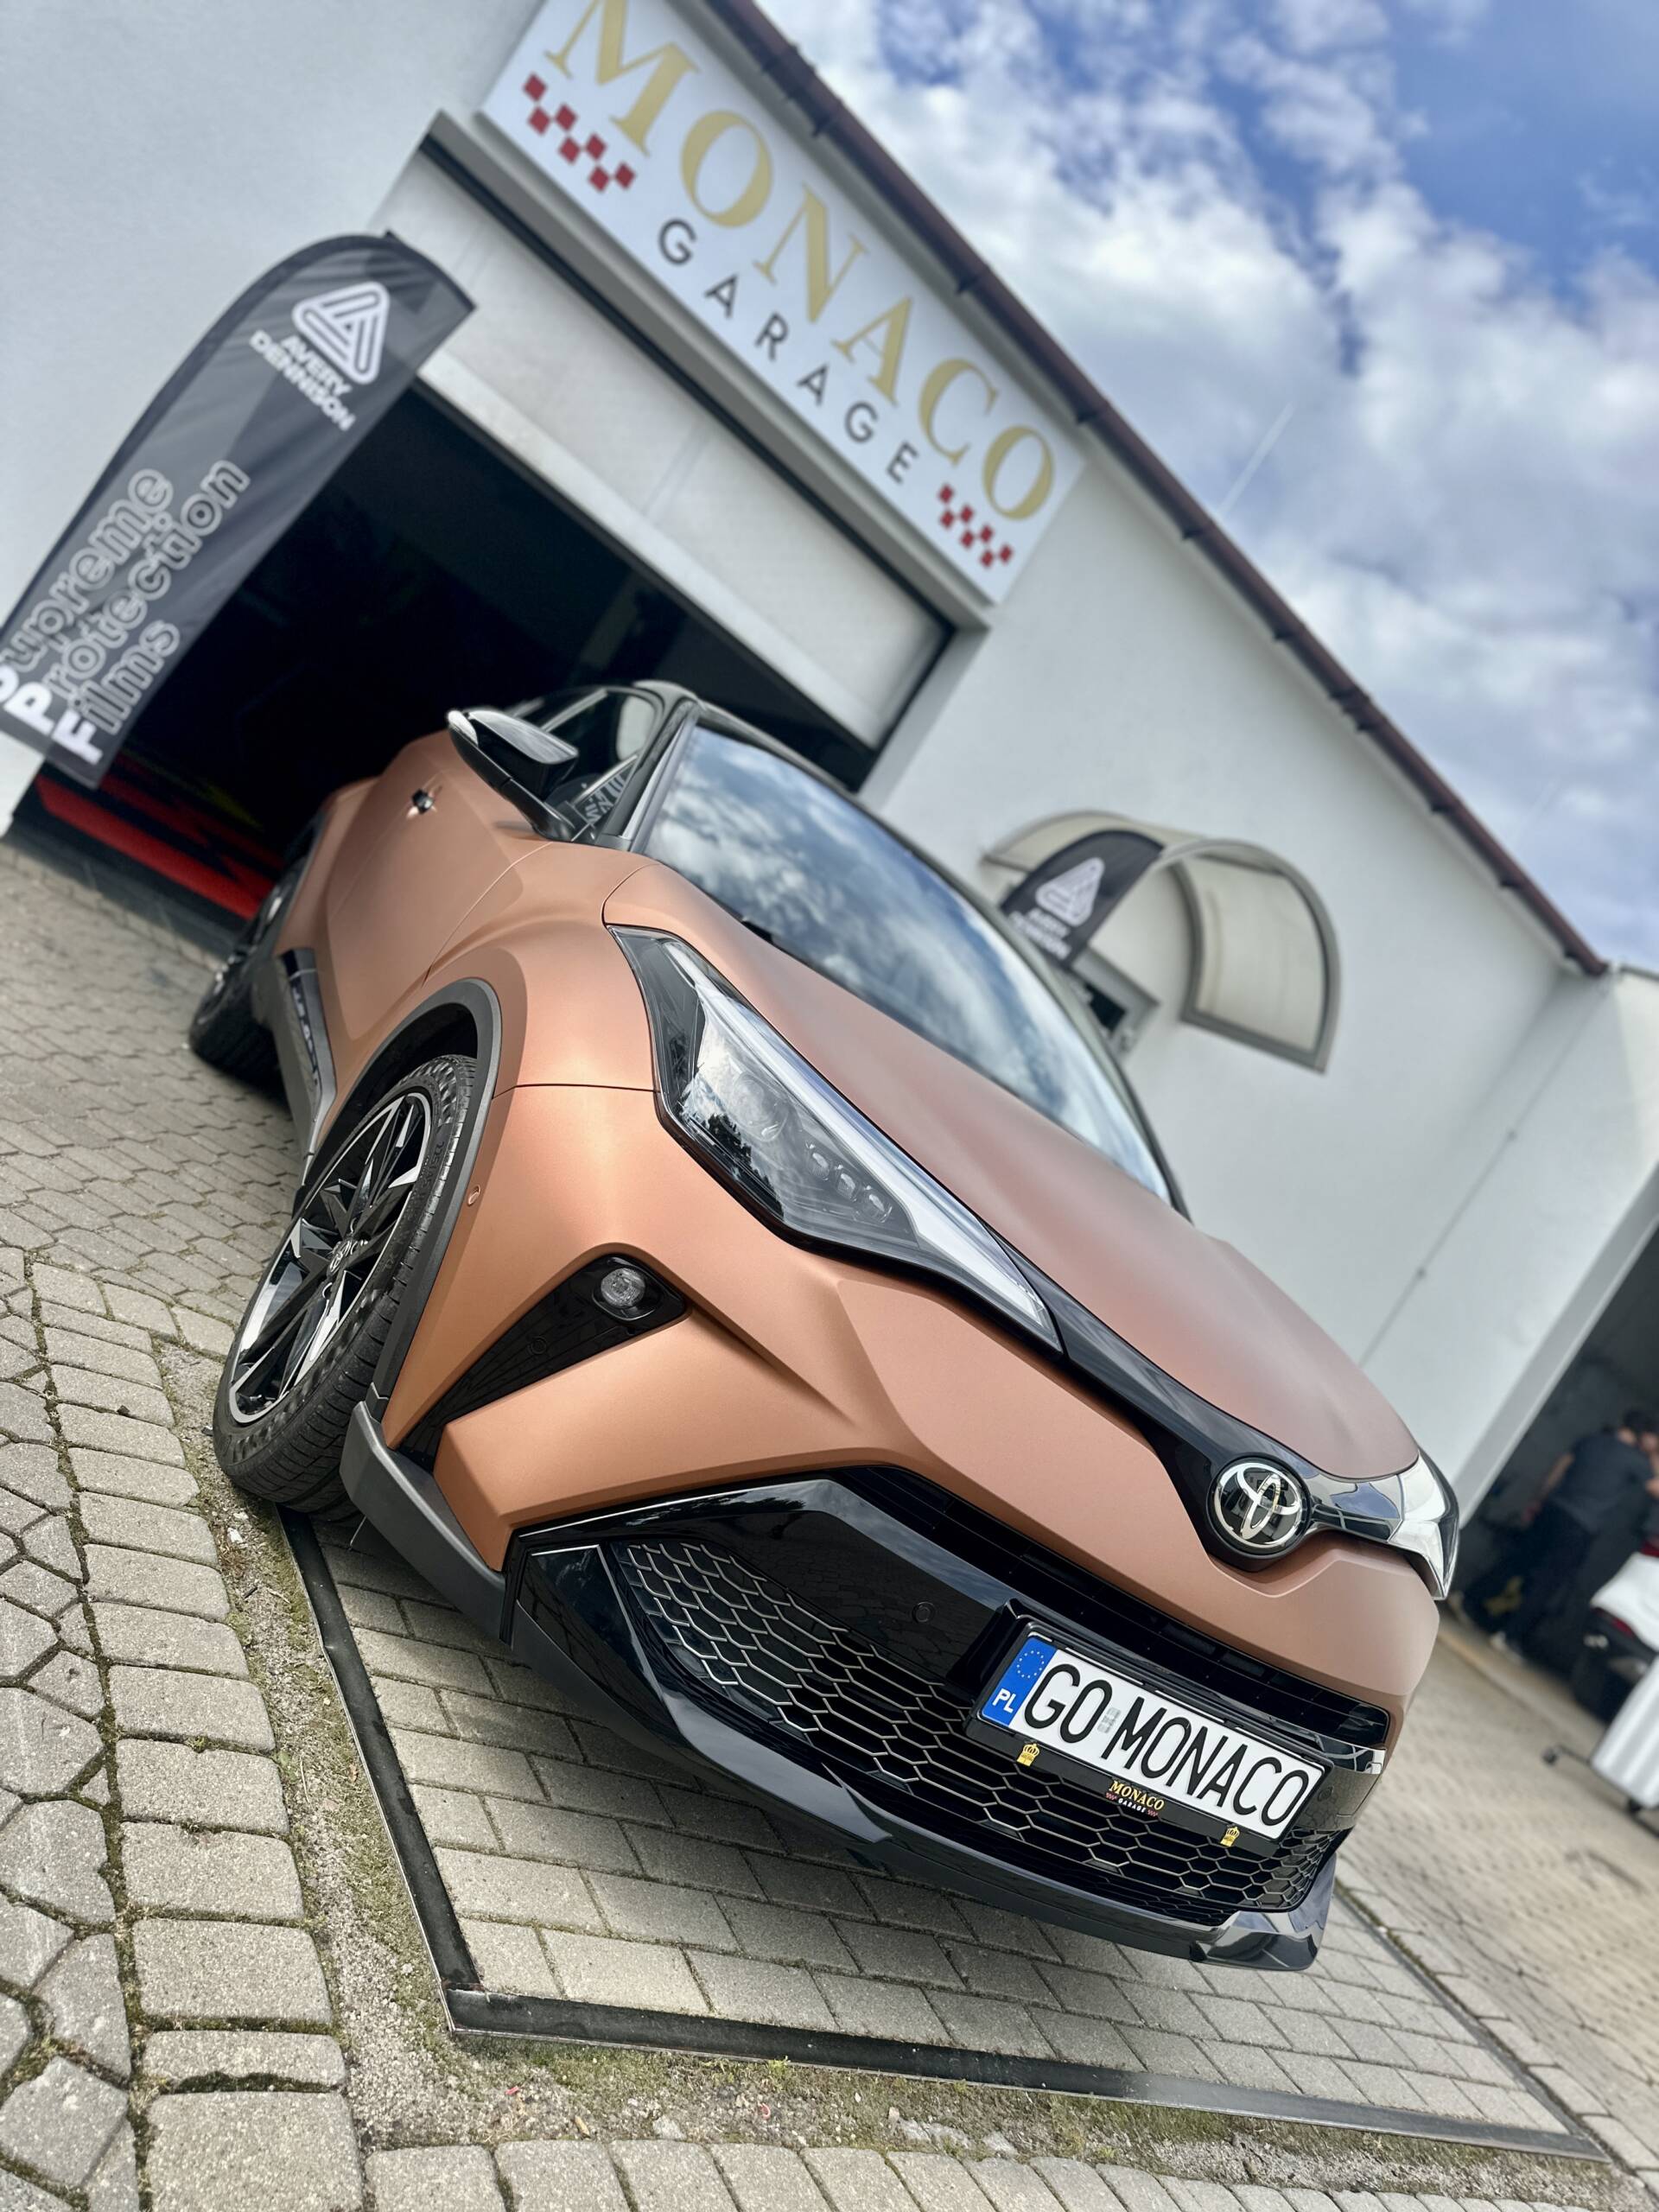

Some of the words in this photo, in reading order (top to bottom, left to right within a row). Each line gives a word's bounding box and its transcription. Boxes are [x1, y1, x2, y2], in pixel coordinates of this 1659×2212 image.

[545, 0, 1053, 521] MONACO
[250, 330, 356, 430] DENNISON
[281, 334, 353, 397] AVERY
[658, 219, 918, 486] GARAGE
[3, 460, 251, 734] Protection
[52, 620, 181, 765] Films
[992, 1688, 1015, 1713] PL
[1023, 1662, 1113, 1744] GO
[1100, 1695, 1310, 1827] MONACO
[1109, 1780, 1165, 1810] MONACO
[1118, 1797, 1147, 1813] GARAGE
